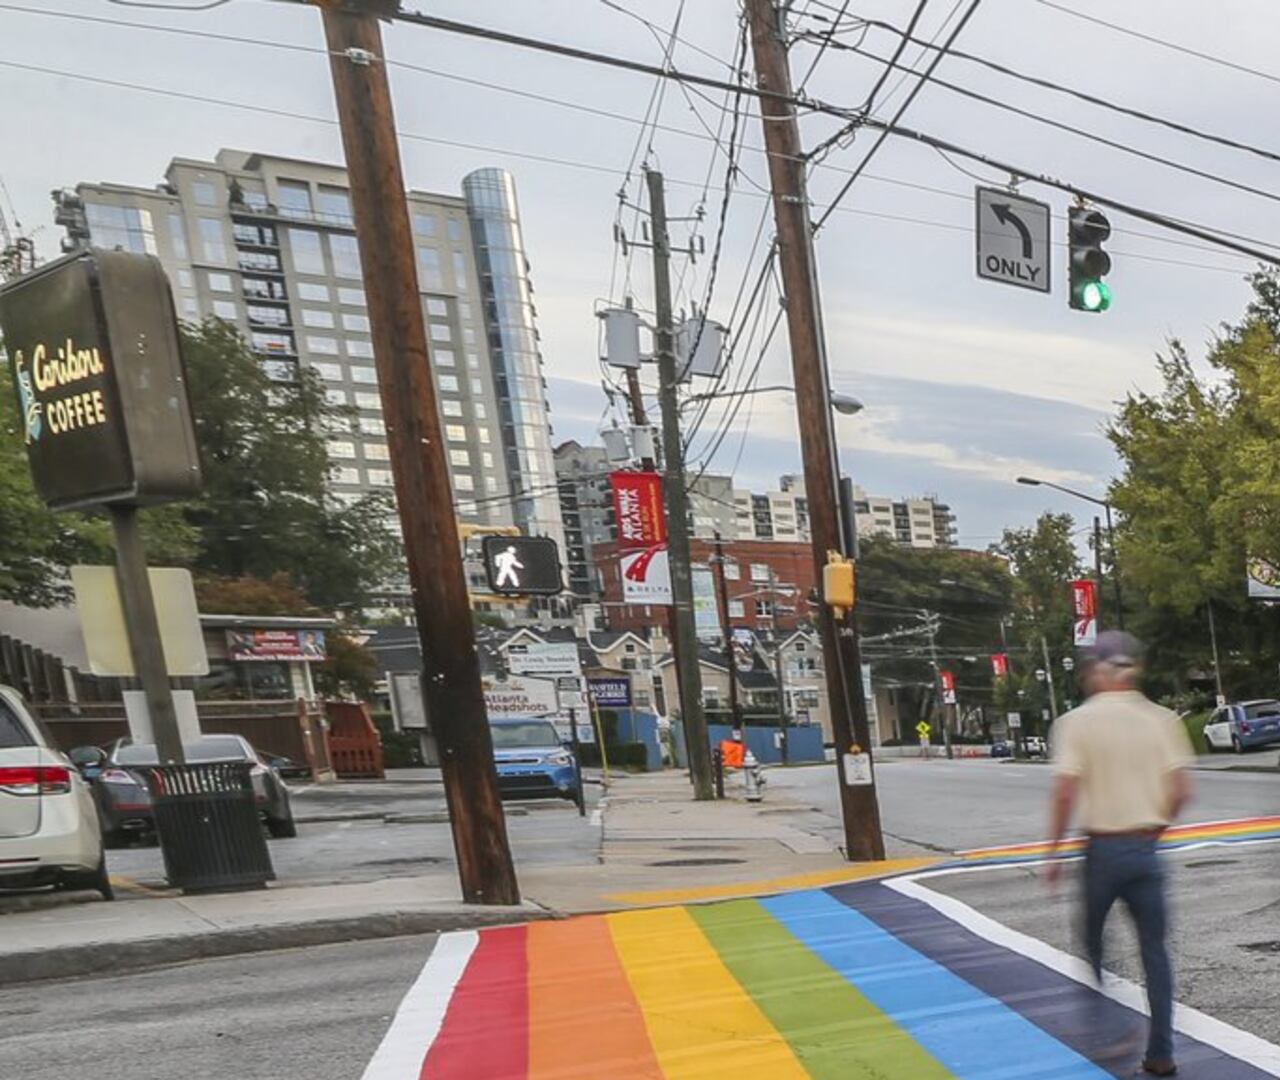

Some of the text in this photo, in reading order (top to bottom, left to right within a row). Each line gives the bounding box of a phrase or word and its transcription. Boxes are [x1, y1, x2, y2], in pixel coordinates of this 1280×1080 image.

[986, 255, 1041, 282] ONLY
[33, 338, 104, 391] Caribou
[47, 390, 106, 434] COFFEE
